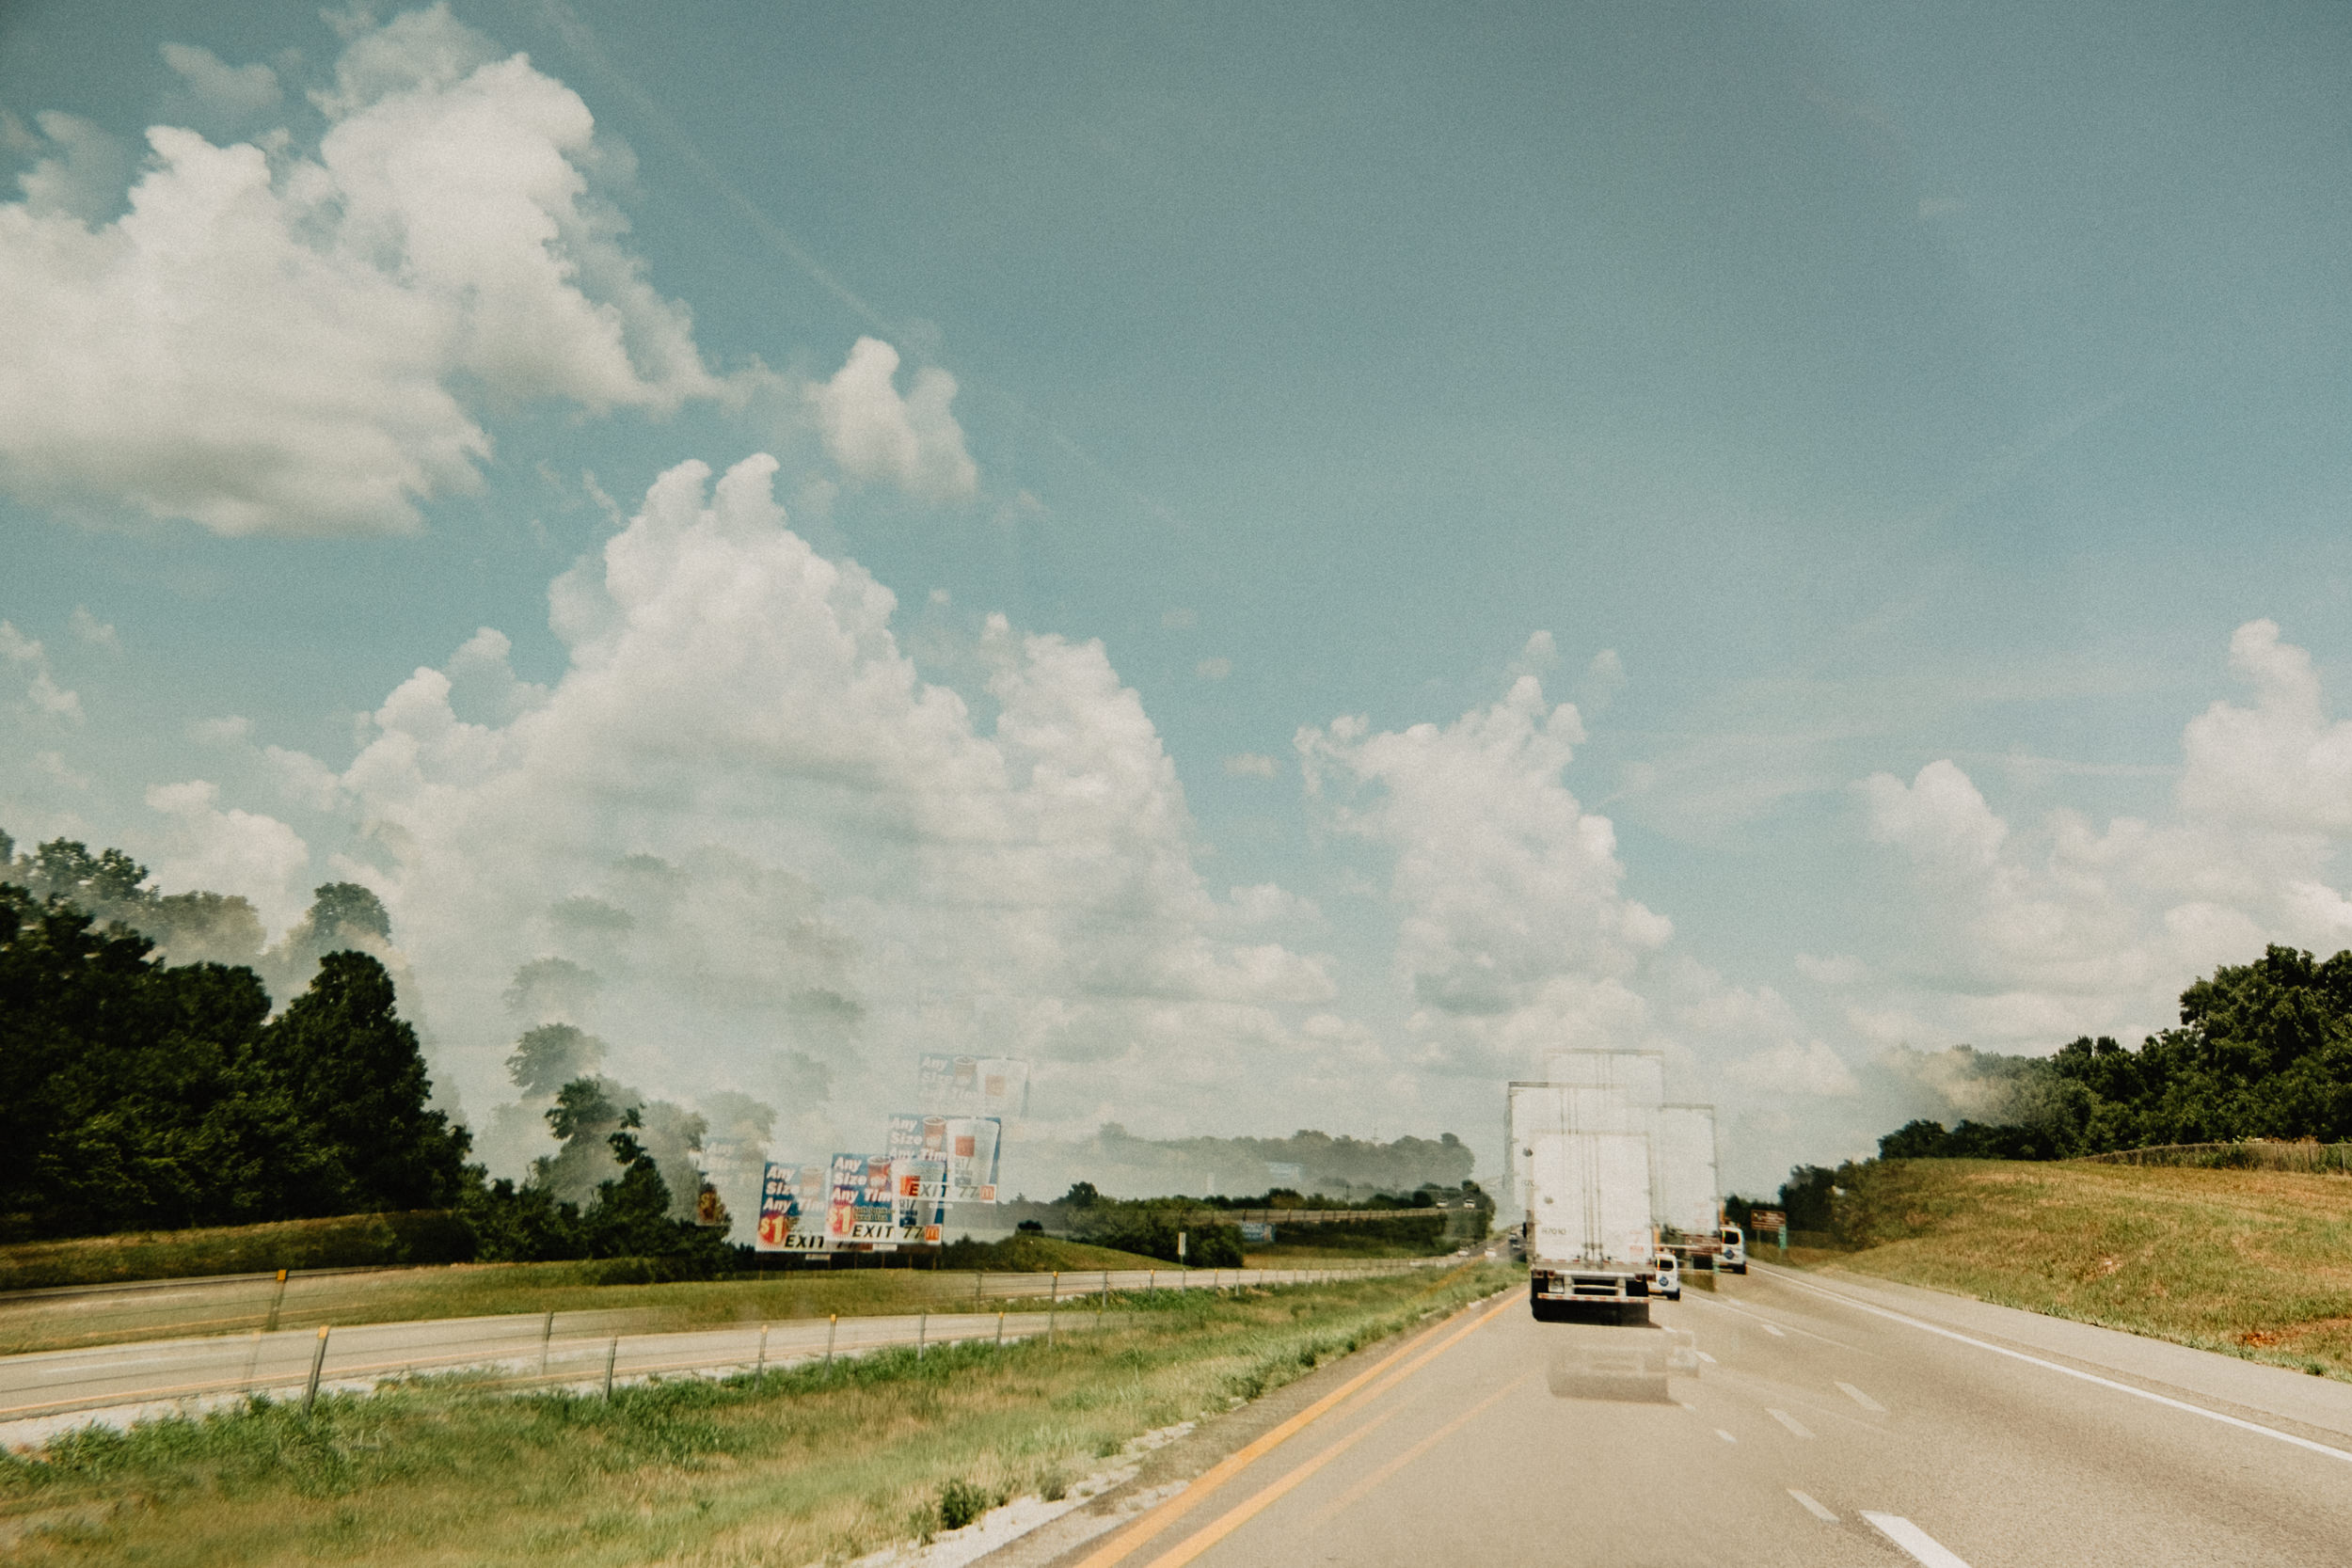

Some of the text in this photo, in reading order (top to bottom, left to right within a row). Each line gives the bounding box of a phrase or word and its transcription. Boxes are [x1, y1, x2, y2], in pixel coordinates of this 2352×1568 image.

[889, 1117, 918, 1132] Any
[890, 1131, 923, 1145] Size
[834, 1156, 862, 1173] Any
[766, 1164, 796, 1182] Any
[834, 1172, 867, 1185] Size
[765, 1181, 801, 1196] Size
[831, 1187, 859, 1204] Any
[908, 1183, 948, 1197] EXIT
[763, 1196, 793, 1214] Any
[828, 1206, 851, 1234] $1
[760, 1215, 785, 1243] $1
[851, 1225, 895, 1239] EXIT
